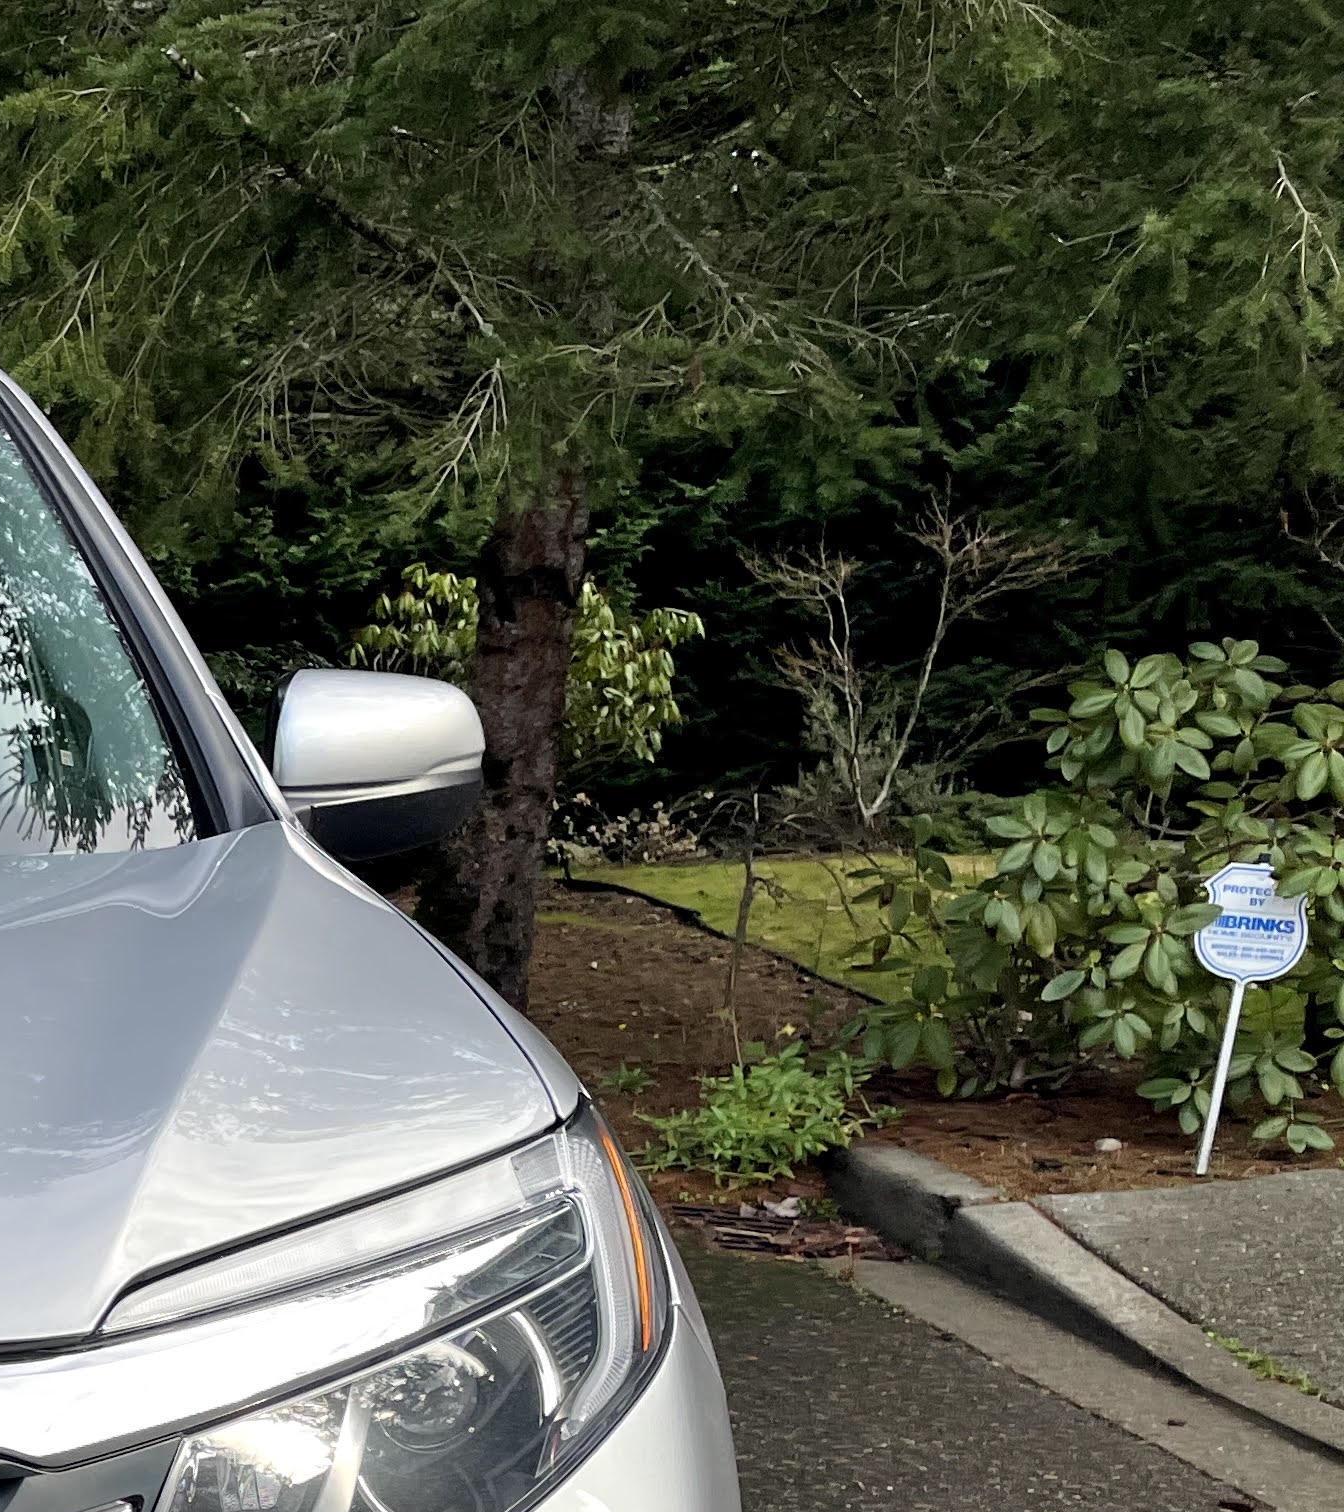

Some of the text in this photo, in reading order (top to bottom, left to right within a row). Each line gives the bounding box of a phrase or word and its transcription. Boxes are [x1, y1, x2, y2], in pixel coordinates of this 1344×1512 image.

[1223, 884, 1273, 897] PROTEC
[1249, 897, 1266, 907] BY
[1222, 915, 1296, 934] BRINKS
